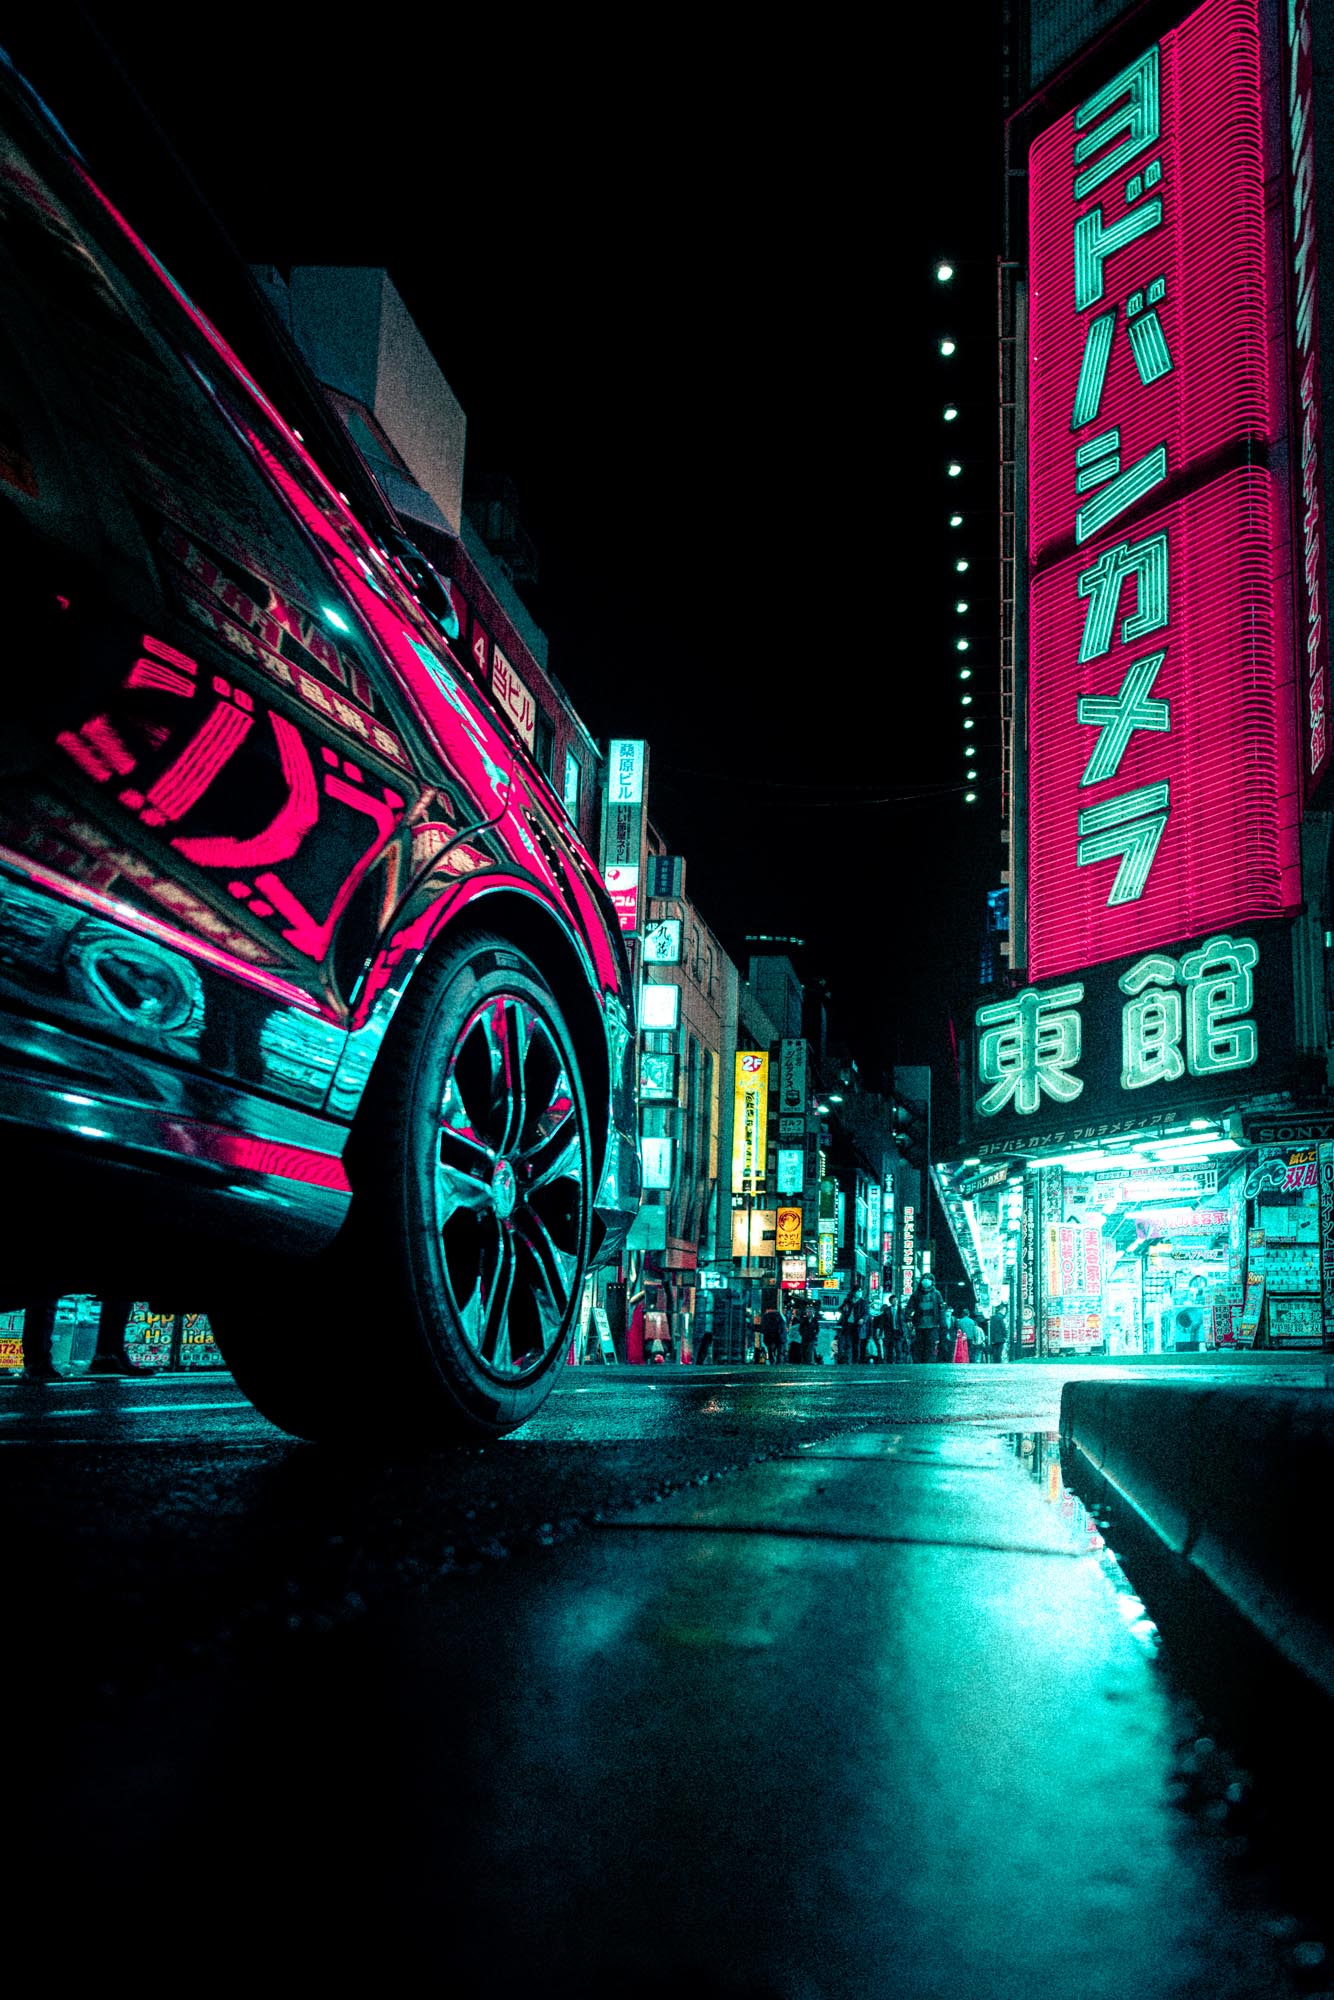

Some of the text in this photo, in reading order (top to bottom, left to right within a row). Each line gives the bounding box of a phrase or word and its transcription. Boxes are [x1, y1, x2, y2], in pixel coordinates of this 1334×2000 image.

[1070, 42, 1174, 908] ヨドバシカメラ
[473, 637, 486, 670] 4
[494, 655, 533, 732] 当ビル
[618, 743, 635, 800] 桑原ビル
[975, 935, 1260, 1117] 東館
[742, 1056, 762, 1072] 2F
[978, 1131, 1066, 1156] ヨドバシカメラ
[1260, 1126, 1330, 1141] SONY
